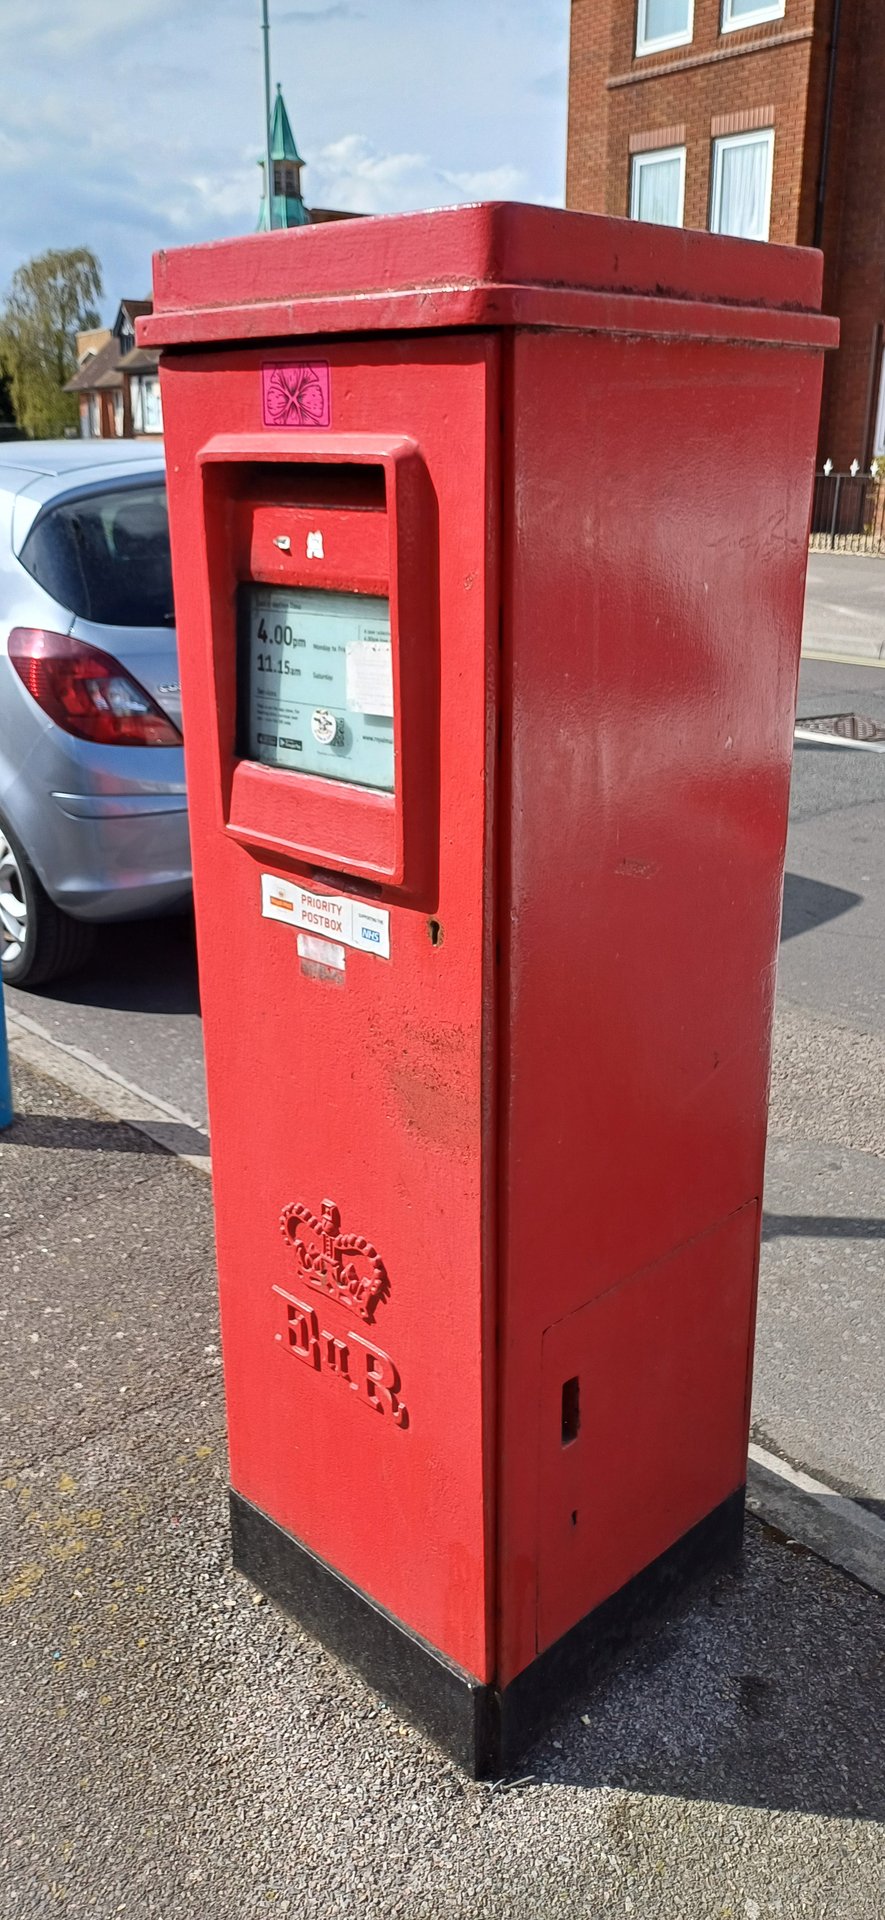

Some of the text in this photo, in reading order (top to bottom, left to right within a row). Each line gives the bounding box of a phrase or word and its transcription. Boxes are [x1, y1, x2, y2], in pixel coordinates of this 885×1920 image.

[257, 618, 306, 648] 4.00pm
[257, 653, 302, 676] 11.15am
[301, 894, 342, 916] PRIORITY
[301, 910, 343, 933] POSTBOX
[362, 928, 379, 942] NHS
